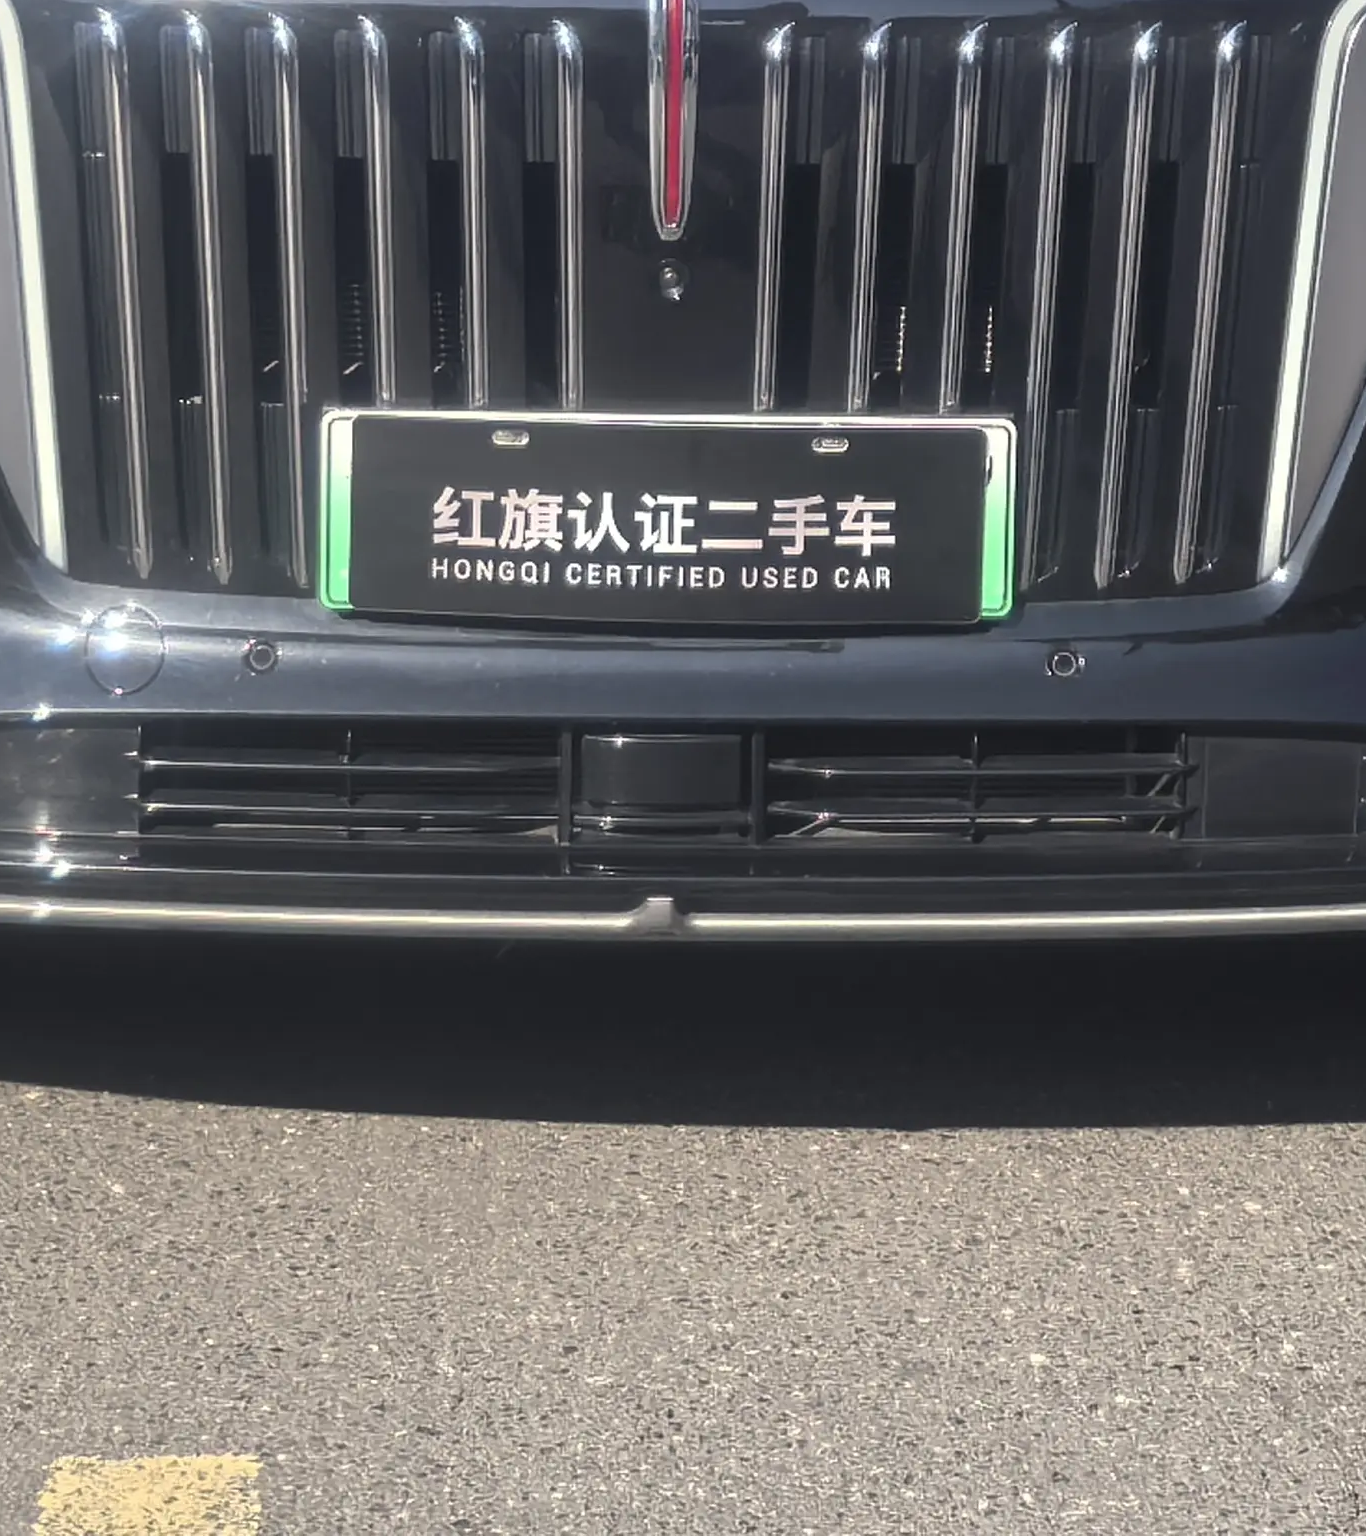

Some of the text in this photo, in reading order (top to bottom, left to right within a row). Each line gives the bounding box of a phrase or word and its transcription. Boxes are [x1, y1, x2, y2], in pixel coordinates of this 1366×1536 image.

[432, 485, 897, 557] 红旗认证二手车
[431, 557, 891, 590] HONGQI CERTIFIED USED CAR
